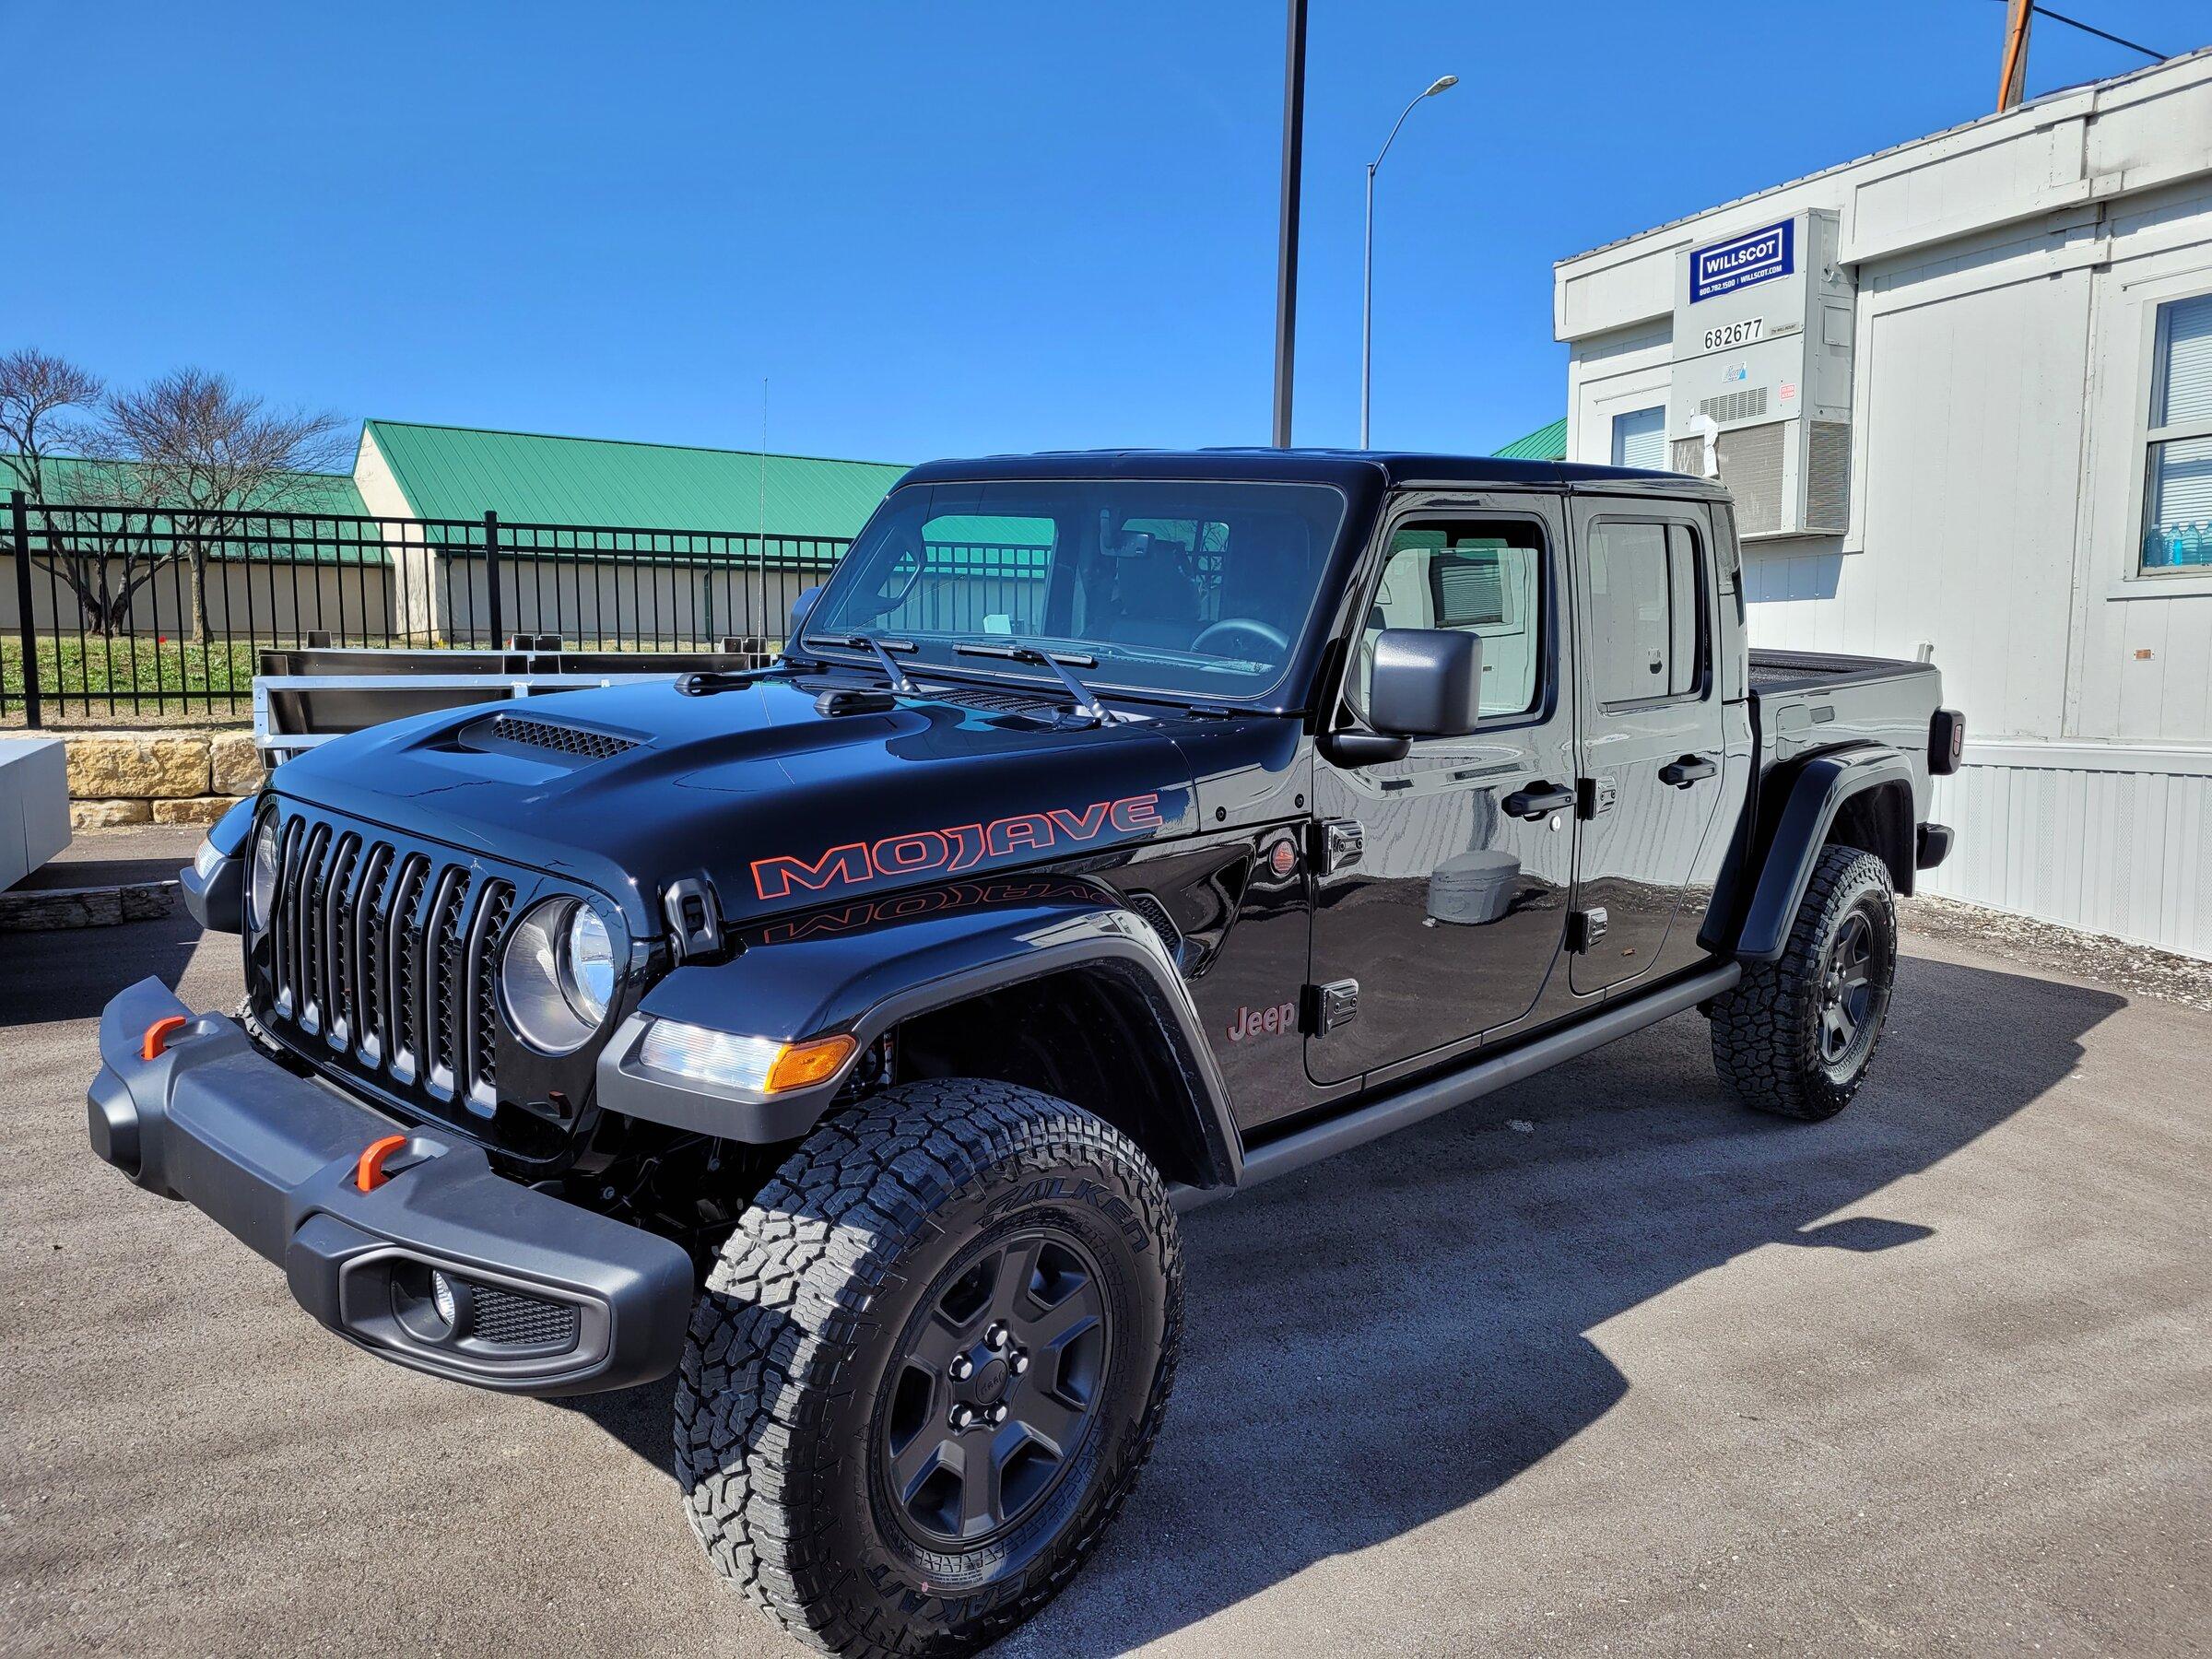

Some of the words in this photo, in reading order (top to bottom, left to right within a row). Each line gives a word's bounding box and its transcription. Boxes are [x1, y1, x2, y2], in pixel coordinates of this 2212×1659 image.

[1707, 241, 1775, 274] WILLSCOT
[1740, 265, 1783, 284] WILLSCOT.COM
[1704, 318, 1762, 349] 682677
[750, 794, 1163, 900] MOJAVE
[1227, 1002, 1295, 1041] Jeep
[974, 1175, 1150, 1254] FALKEN
